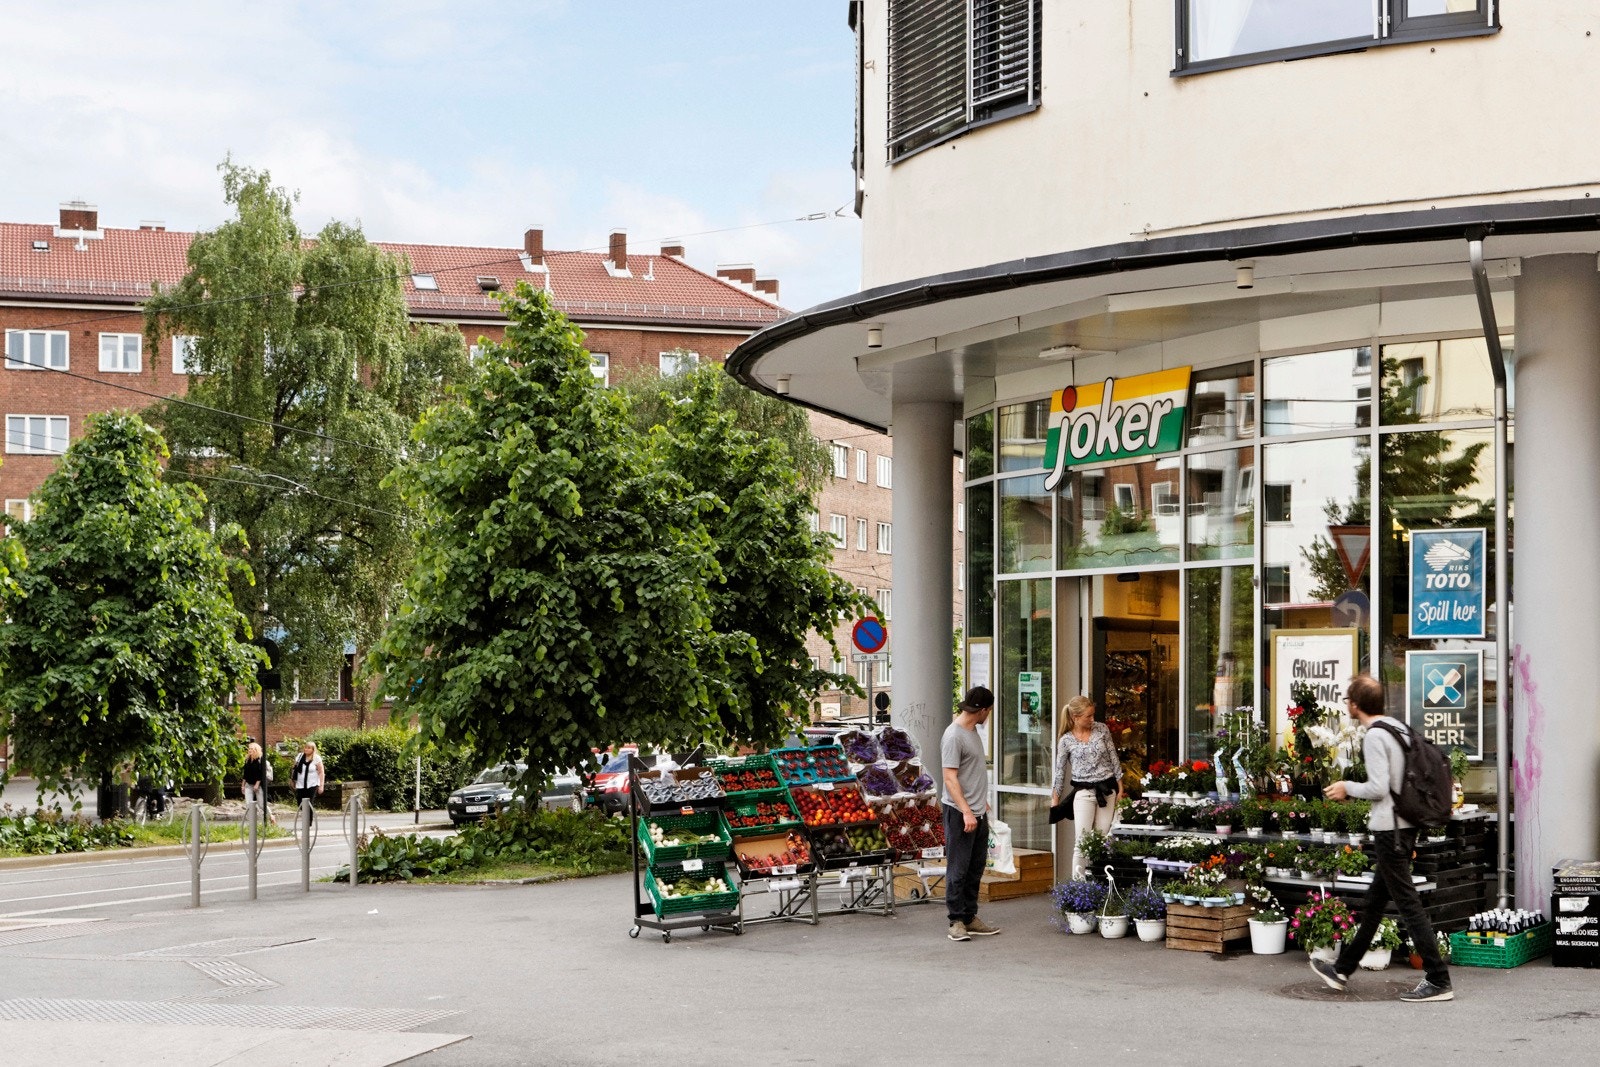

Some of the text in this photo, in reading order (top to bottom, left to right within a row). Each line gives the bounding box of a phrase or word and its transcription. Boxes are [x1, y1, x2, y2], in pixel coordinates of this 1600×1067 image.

[1044, 377, 1174, 491] joker
[1448, 564, 1470, 572] RIKS
[1425, 572, 1471, 589] TOTO
[1418, 600, 1477, 626] Spill her
[1292, 658, 1339, 680] GRILLET
[1424, 712, 1466, 727] SPILL
[1424, 729, 1465, 745] HER!
